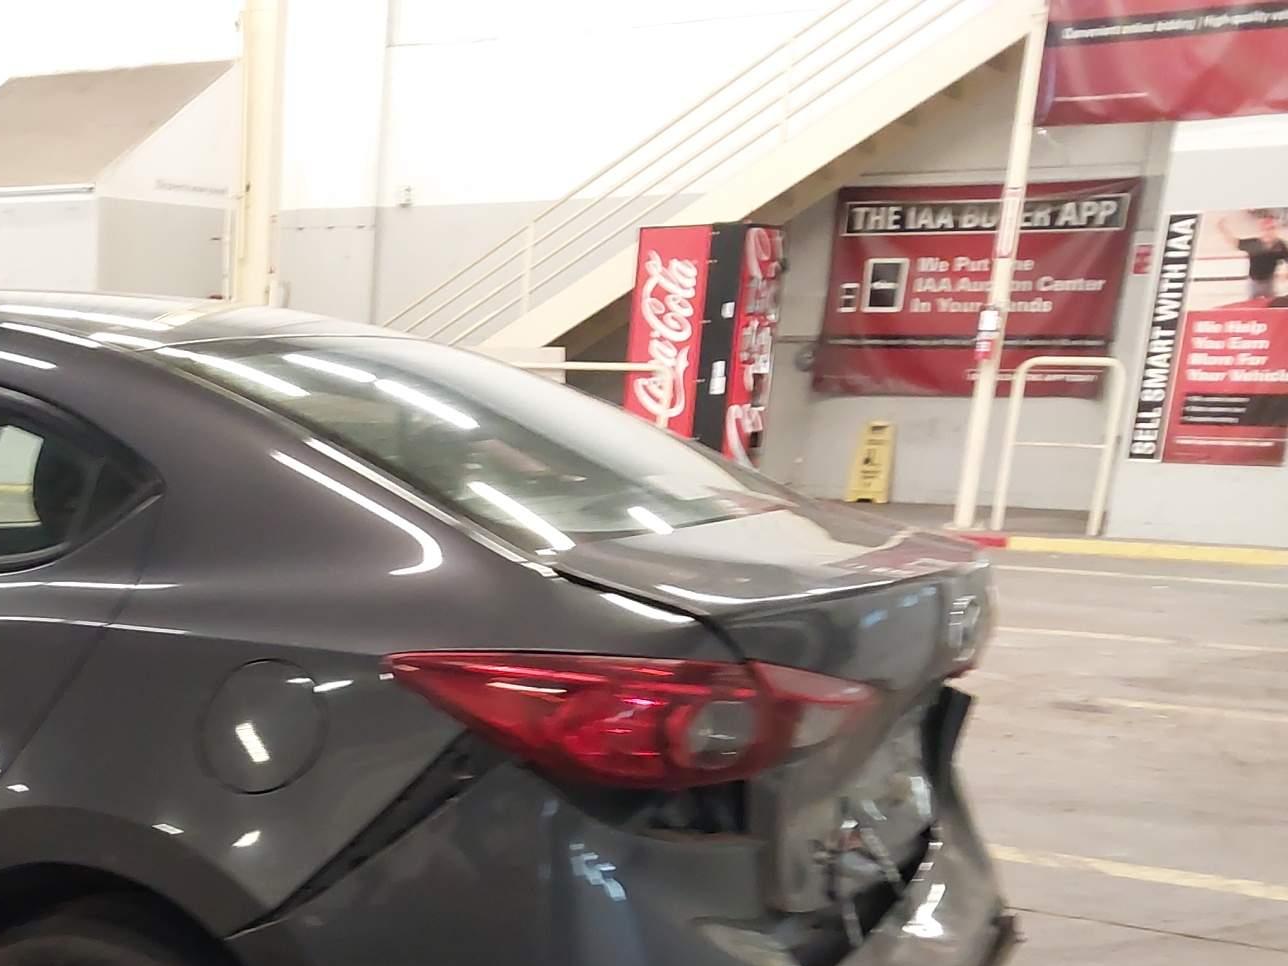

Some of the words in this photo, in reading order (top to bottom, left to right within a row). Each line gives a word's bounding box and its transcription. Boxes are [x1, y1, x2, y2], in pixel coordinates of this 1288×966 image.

[852, 206, 903, 230] THE
[905, 206, 954, 229] IAA
[958, 204, 1052, 228] BUER
[1055, 200, 1118, 227] APP
[1165, 217, 1197, 258] IAA
[913, 277, 952, 292] IAA
[1035, 276, 1107, 292] Center
[916, 257, 950, 272] We
[953, 256, 991, 272] Put
[1153, 263, 1187, 320] WITH
[633, 249, 698, 418] Coa-Cola
[1140, 325, 1176, 401] SMART
[1130, 406, 1163, 455] SELL
